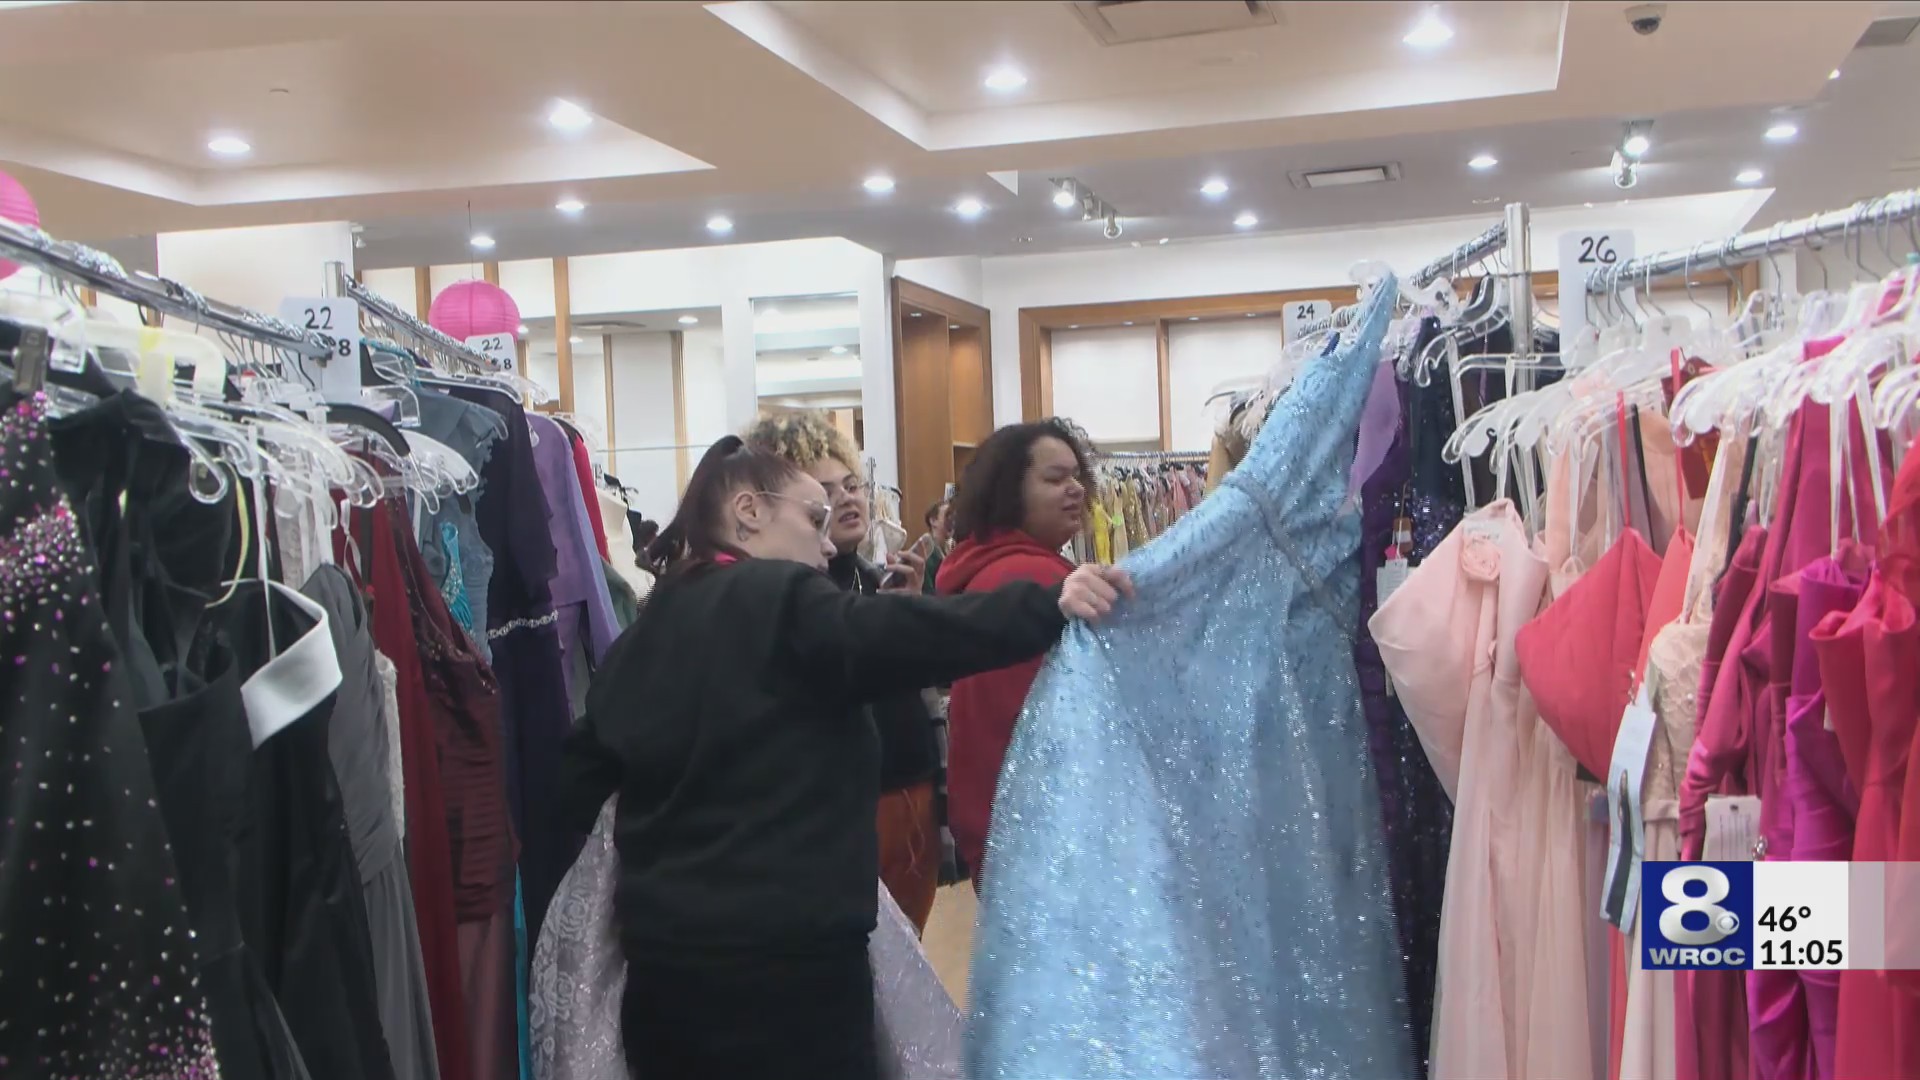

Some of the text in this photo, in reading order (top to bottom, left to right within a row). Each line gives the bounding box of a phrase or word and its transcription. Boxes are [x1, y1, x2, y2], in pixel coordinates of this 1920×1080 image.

[1578, 235, 1617, 264] 26
[304, 306, 334, 330] 22
[1297, 303, 1315, 320] 24
[481, 337, 503, 351] 22
